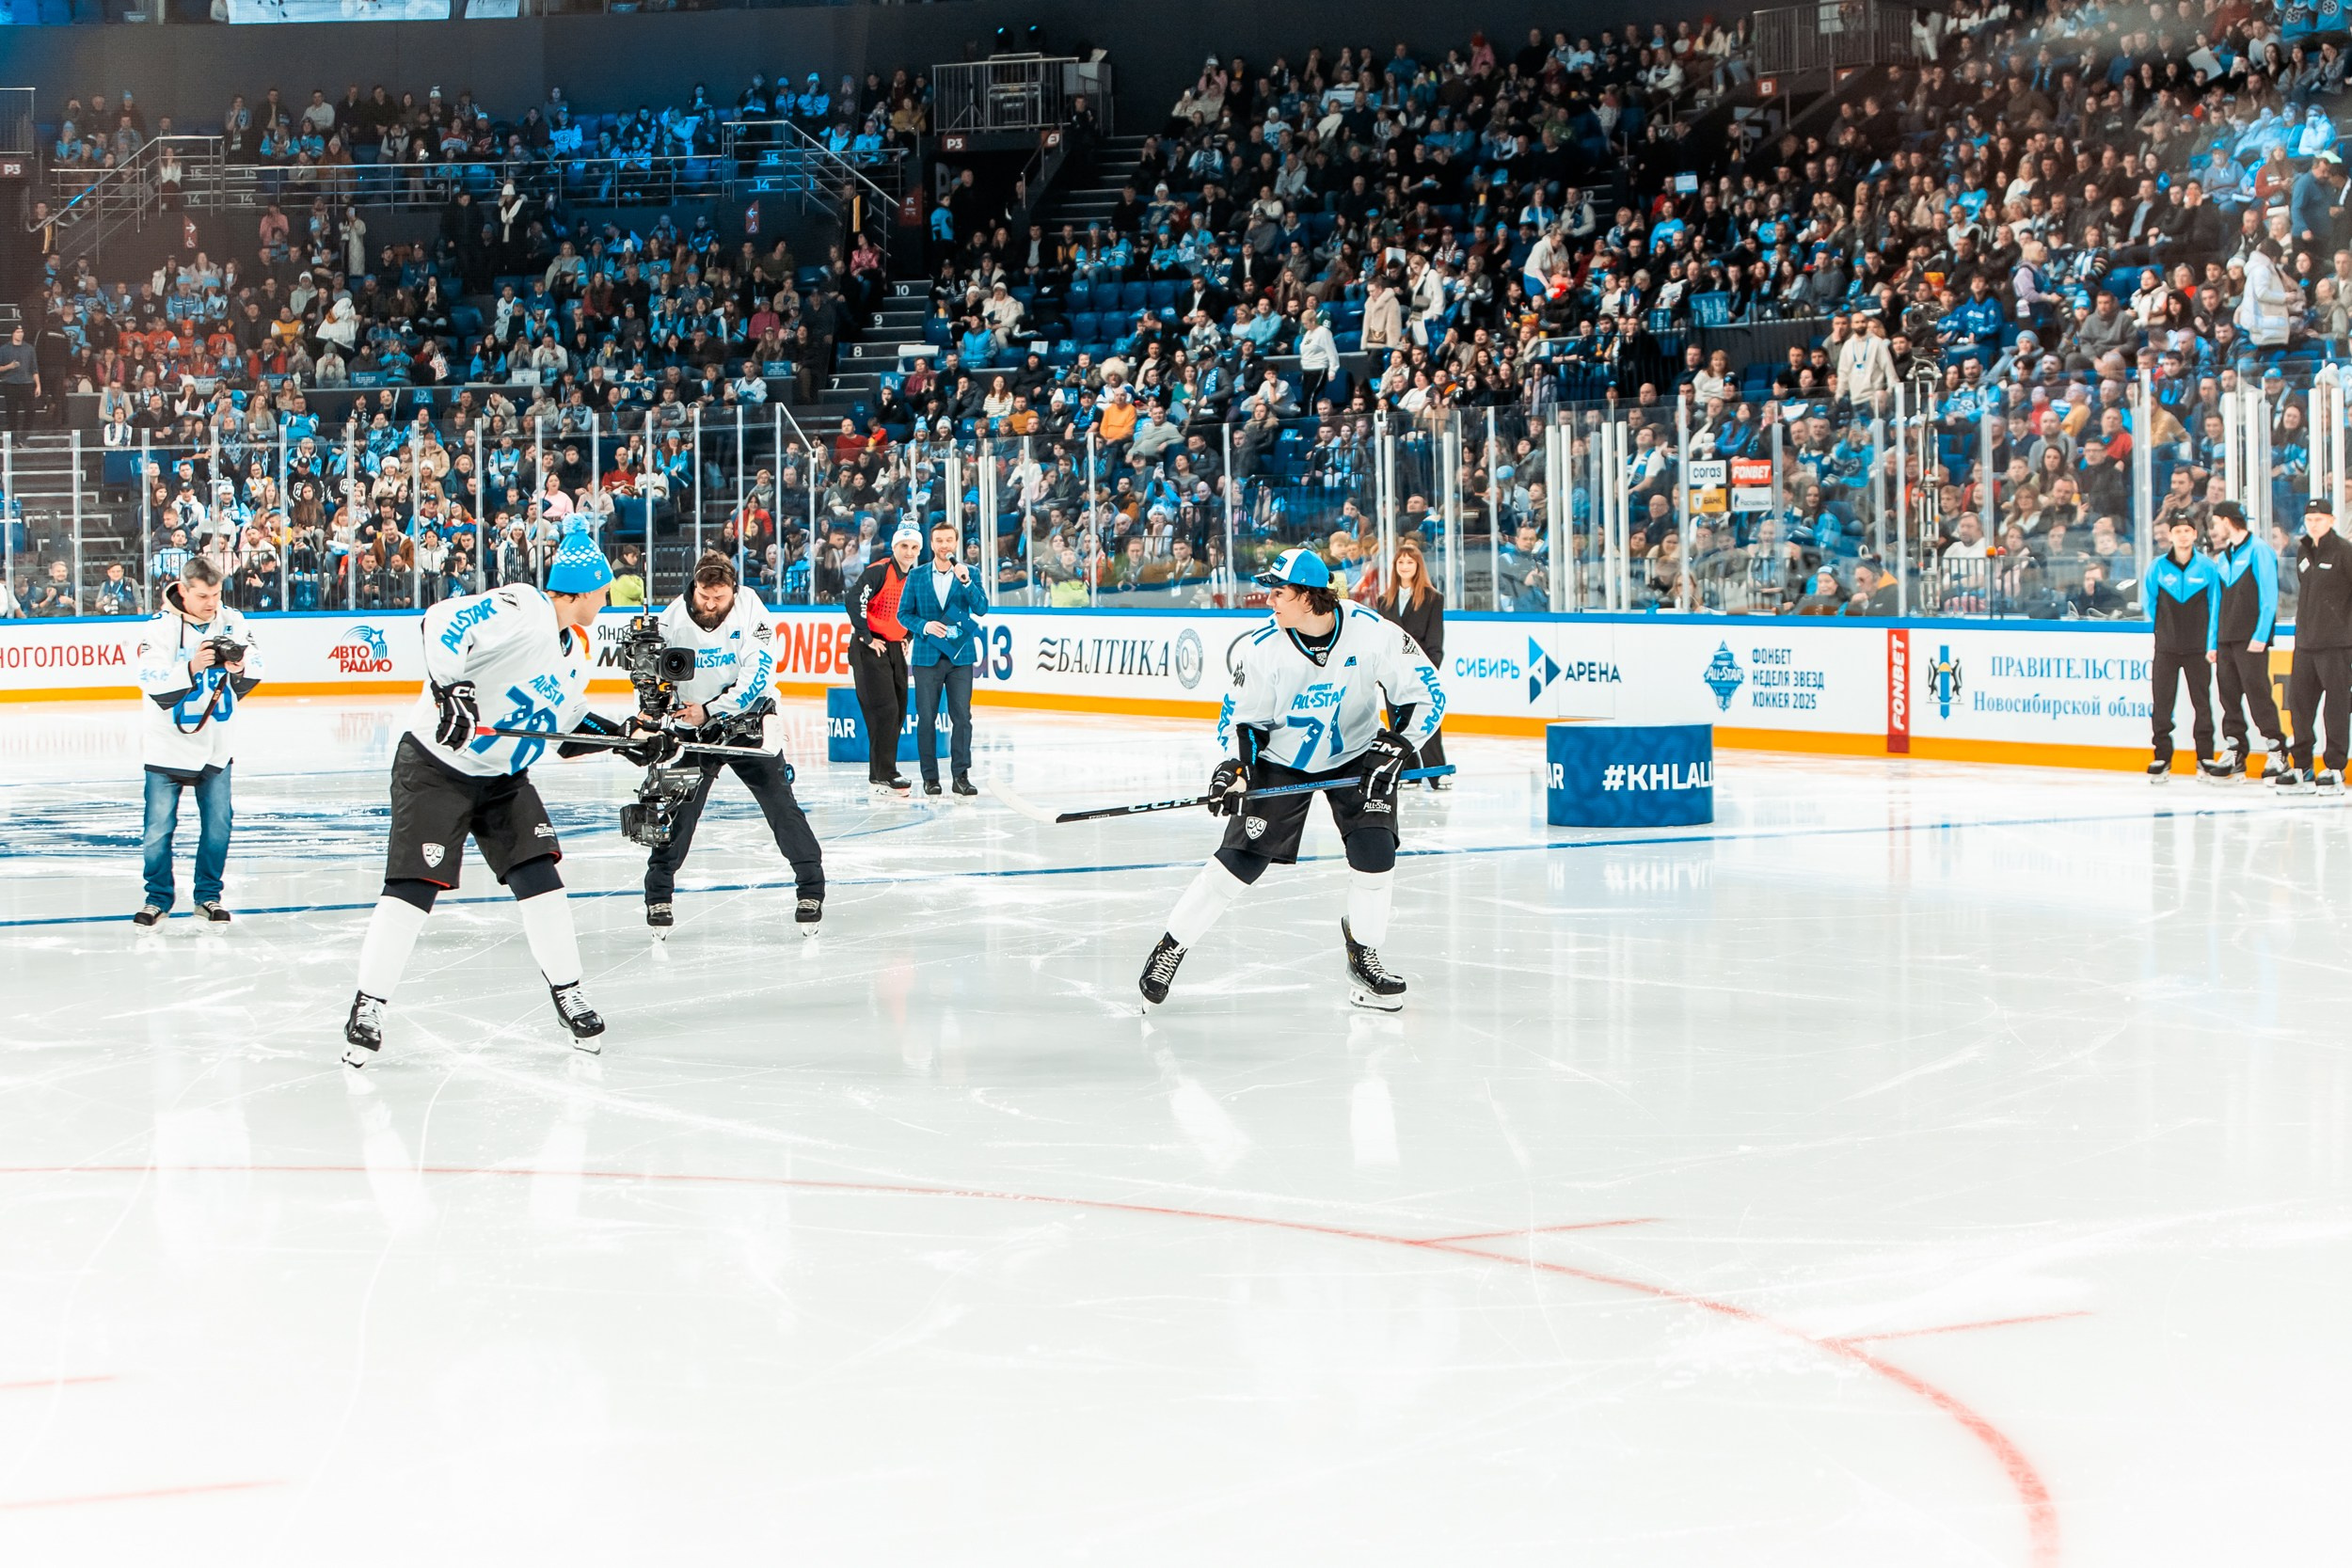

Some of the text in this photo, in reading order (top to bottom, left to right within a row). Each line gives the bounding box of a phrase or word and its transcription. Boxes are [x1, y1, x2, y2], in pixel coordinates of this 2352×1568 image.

[947, 139, 962, 149] P3
[766, 154, 779, 164] 15
[4, 164, 21, 175] P3
[756, 180, 770, 191] 14
[187, 195, 200, 205] 14
[240, 194, 253, 204] 14
[896, 285, 909, 295] 10
[874, 314, 882, 325] 9
[853, 346, 863, 357] 8
[832, 378, 840, 389] 7
[1693, 467, 1722, 479] согаз
[1733, 465, 1771, 480] FONBET
[327, 645, 370, 658] АВТО
[775, 622, 852, 674] ONBE
[1057, 638, 1169, 676] БАЛТИКА
[1752, 648, 1792, 665] ФОНБЕТ
[340, 658, 392, 673] РАДИО
[1455, 657, 1622, 683] СИБИРЬ АРЕНА
[1752, 670, 1825, 690] НЕДЕЛЯ ЗВЕЗД
[1891, 635, 1906, 731] FONBET
[1752, 691, 1818, 709] ХОККЕЯ 2025
[1974, 690, 2101, 721] Новосибирской
[828, 718, 856, 738] TAR
[1370, 740, 1403, 756] CM
[1547, 763, 1565, 790] AR
[1128, 798, 1199, 812] CCM
